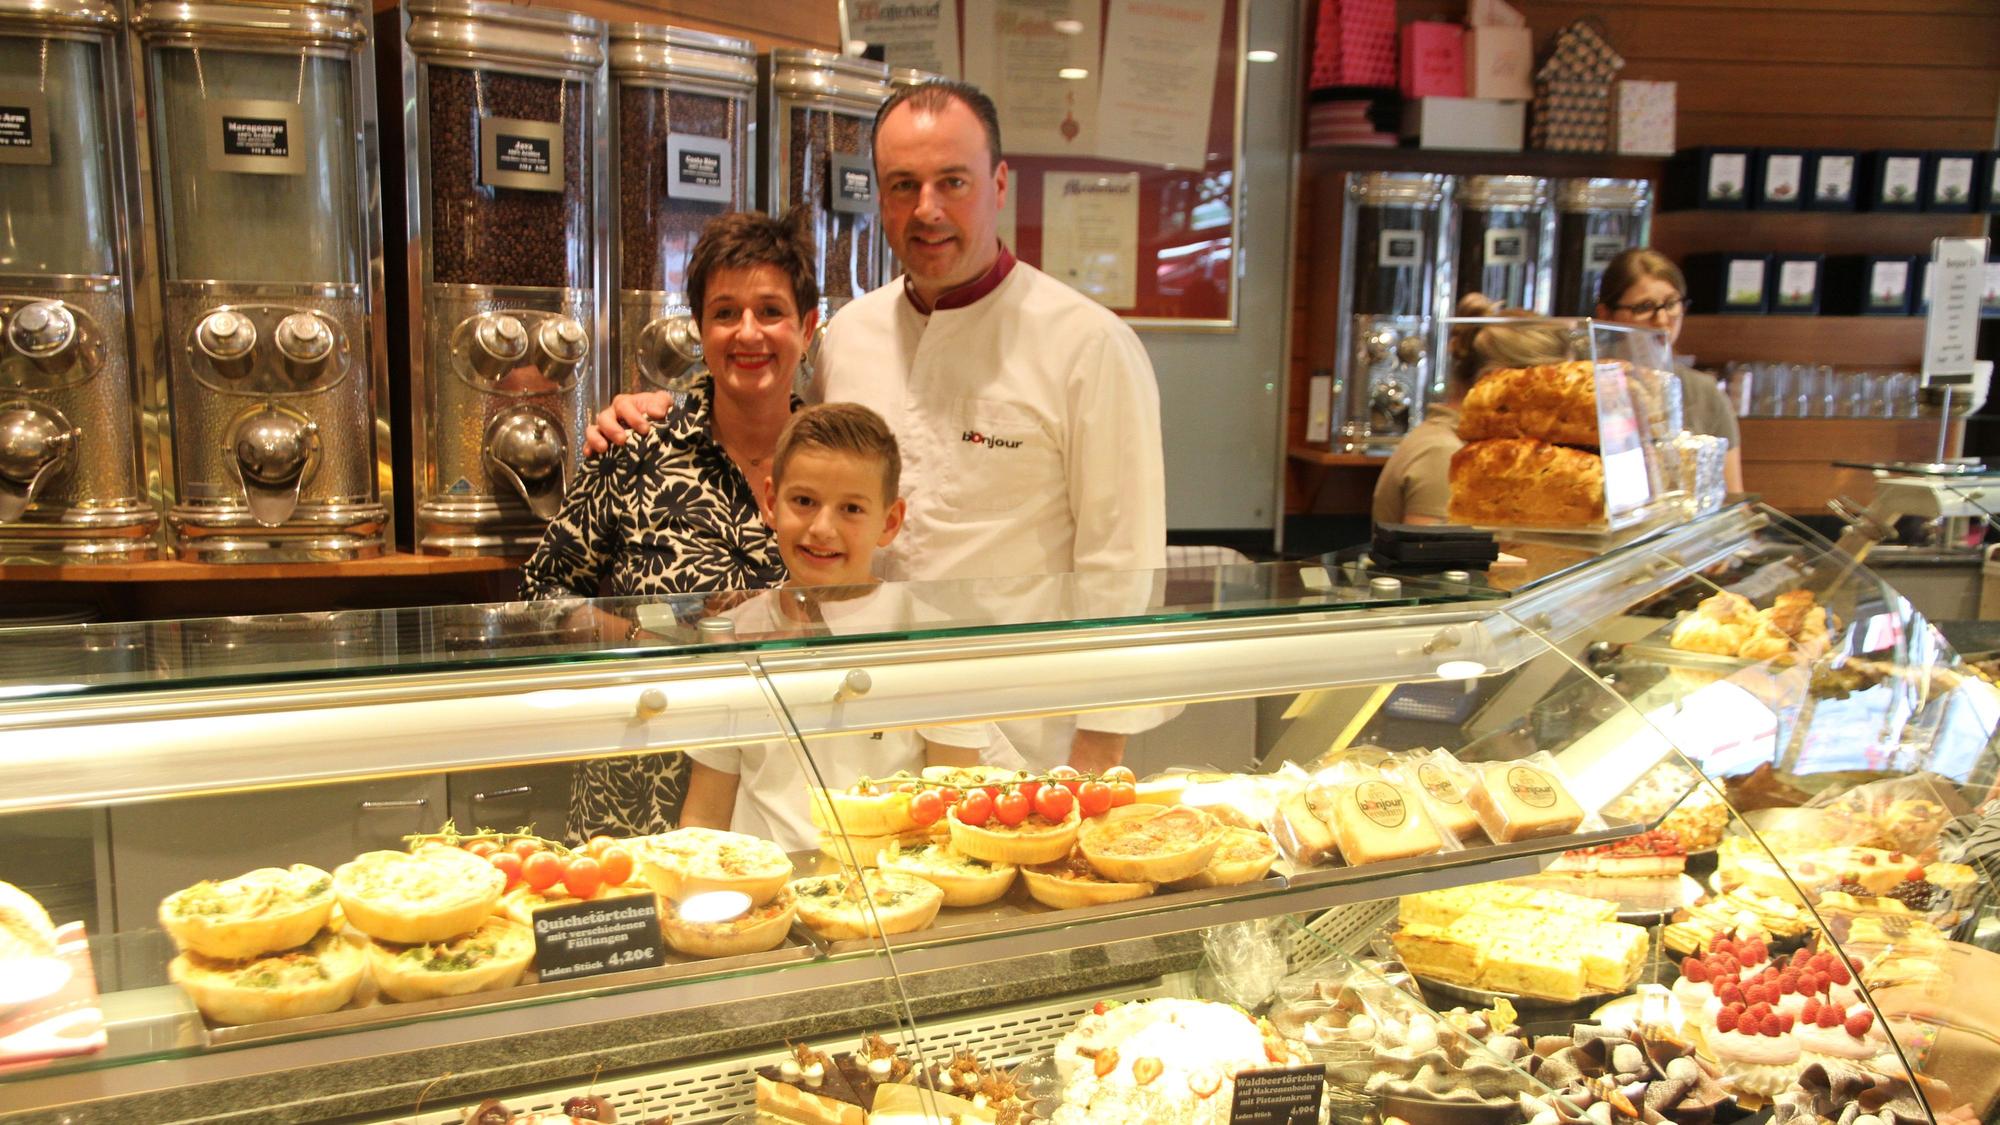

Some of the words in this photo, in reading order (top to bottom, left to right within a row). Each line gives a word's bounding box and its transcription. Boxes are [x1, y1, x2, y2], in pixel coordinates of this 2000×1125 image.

[514, 141, 533, 150] Java
[962, 430, 1023, 449] bonjour
[536, 905, 655, 933] Quichetörtchen
[547, 930, 567, 943] mit
[568, 919, 646, 938] verschiedenen
[567, 932, 629, 950] Füllungen
[542, 966, 572, 977] Laden
[573, 960, 604, 972] Stück
[608, 947, 655, 966] 4,20€
[1237, 1072, 1324, 1088] Waldbeertörtchen
[1238, 1088, 1252, 1097] auf
[1240, 1097, 1254, 1106] mit
